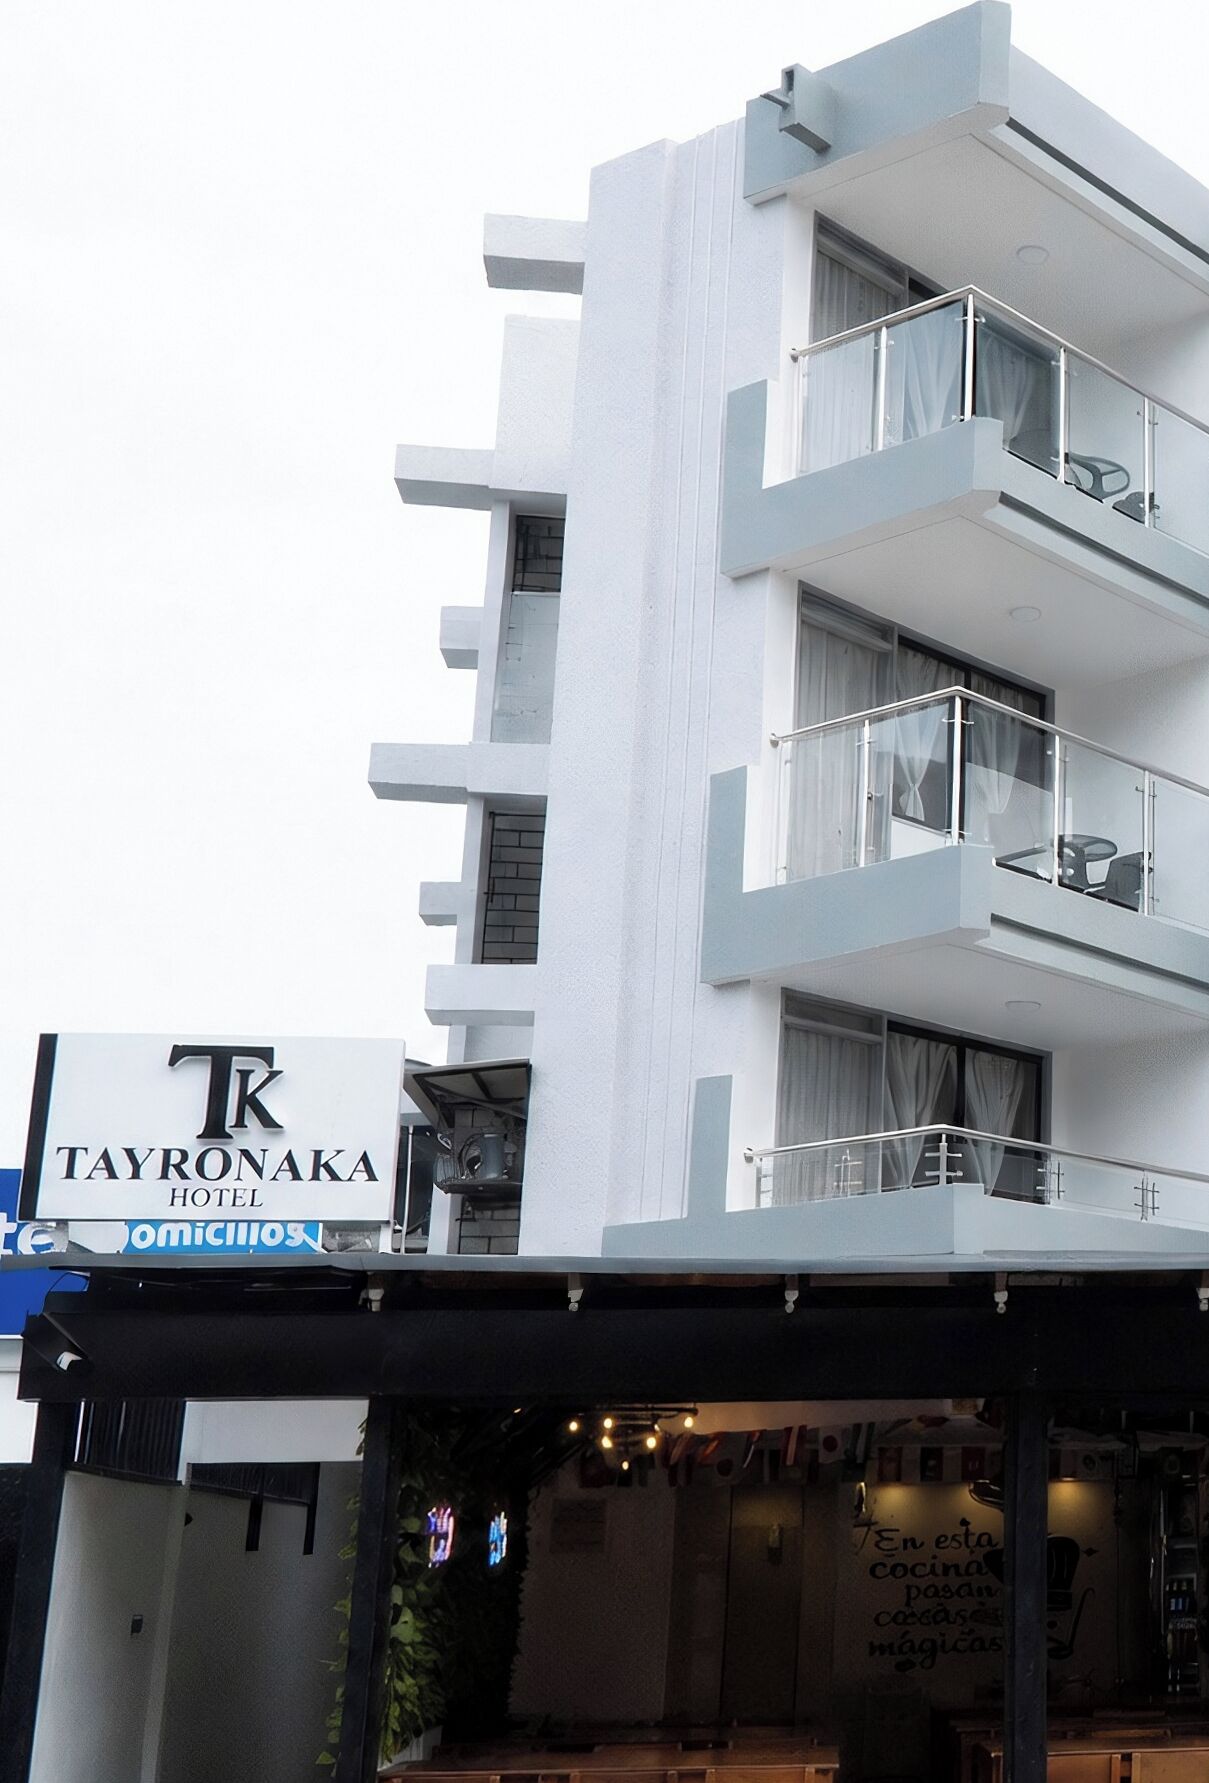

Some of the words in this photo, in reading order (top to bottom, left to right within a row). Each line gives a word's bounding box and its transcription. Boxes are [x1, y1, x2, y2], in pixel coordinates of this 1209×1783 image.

[56, 1146, 380, 1183] TAYRONAKA
[168, 1187, 264, 1209] HOTEL
[874, 1528, 925, 1552] En
[934, 1524, 1000, 1552] esta
[869, 1555, 989, 1580] cocina
[905, 1582, 1000, 1607] pasan
